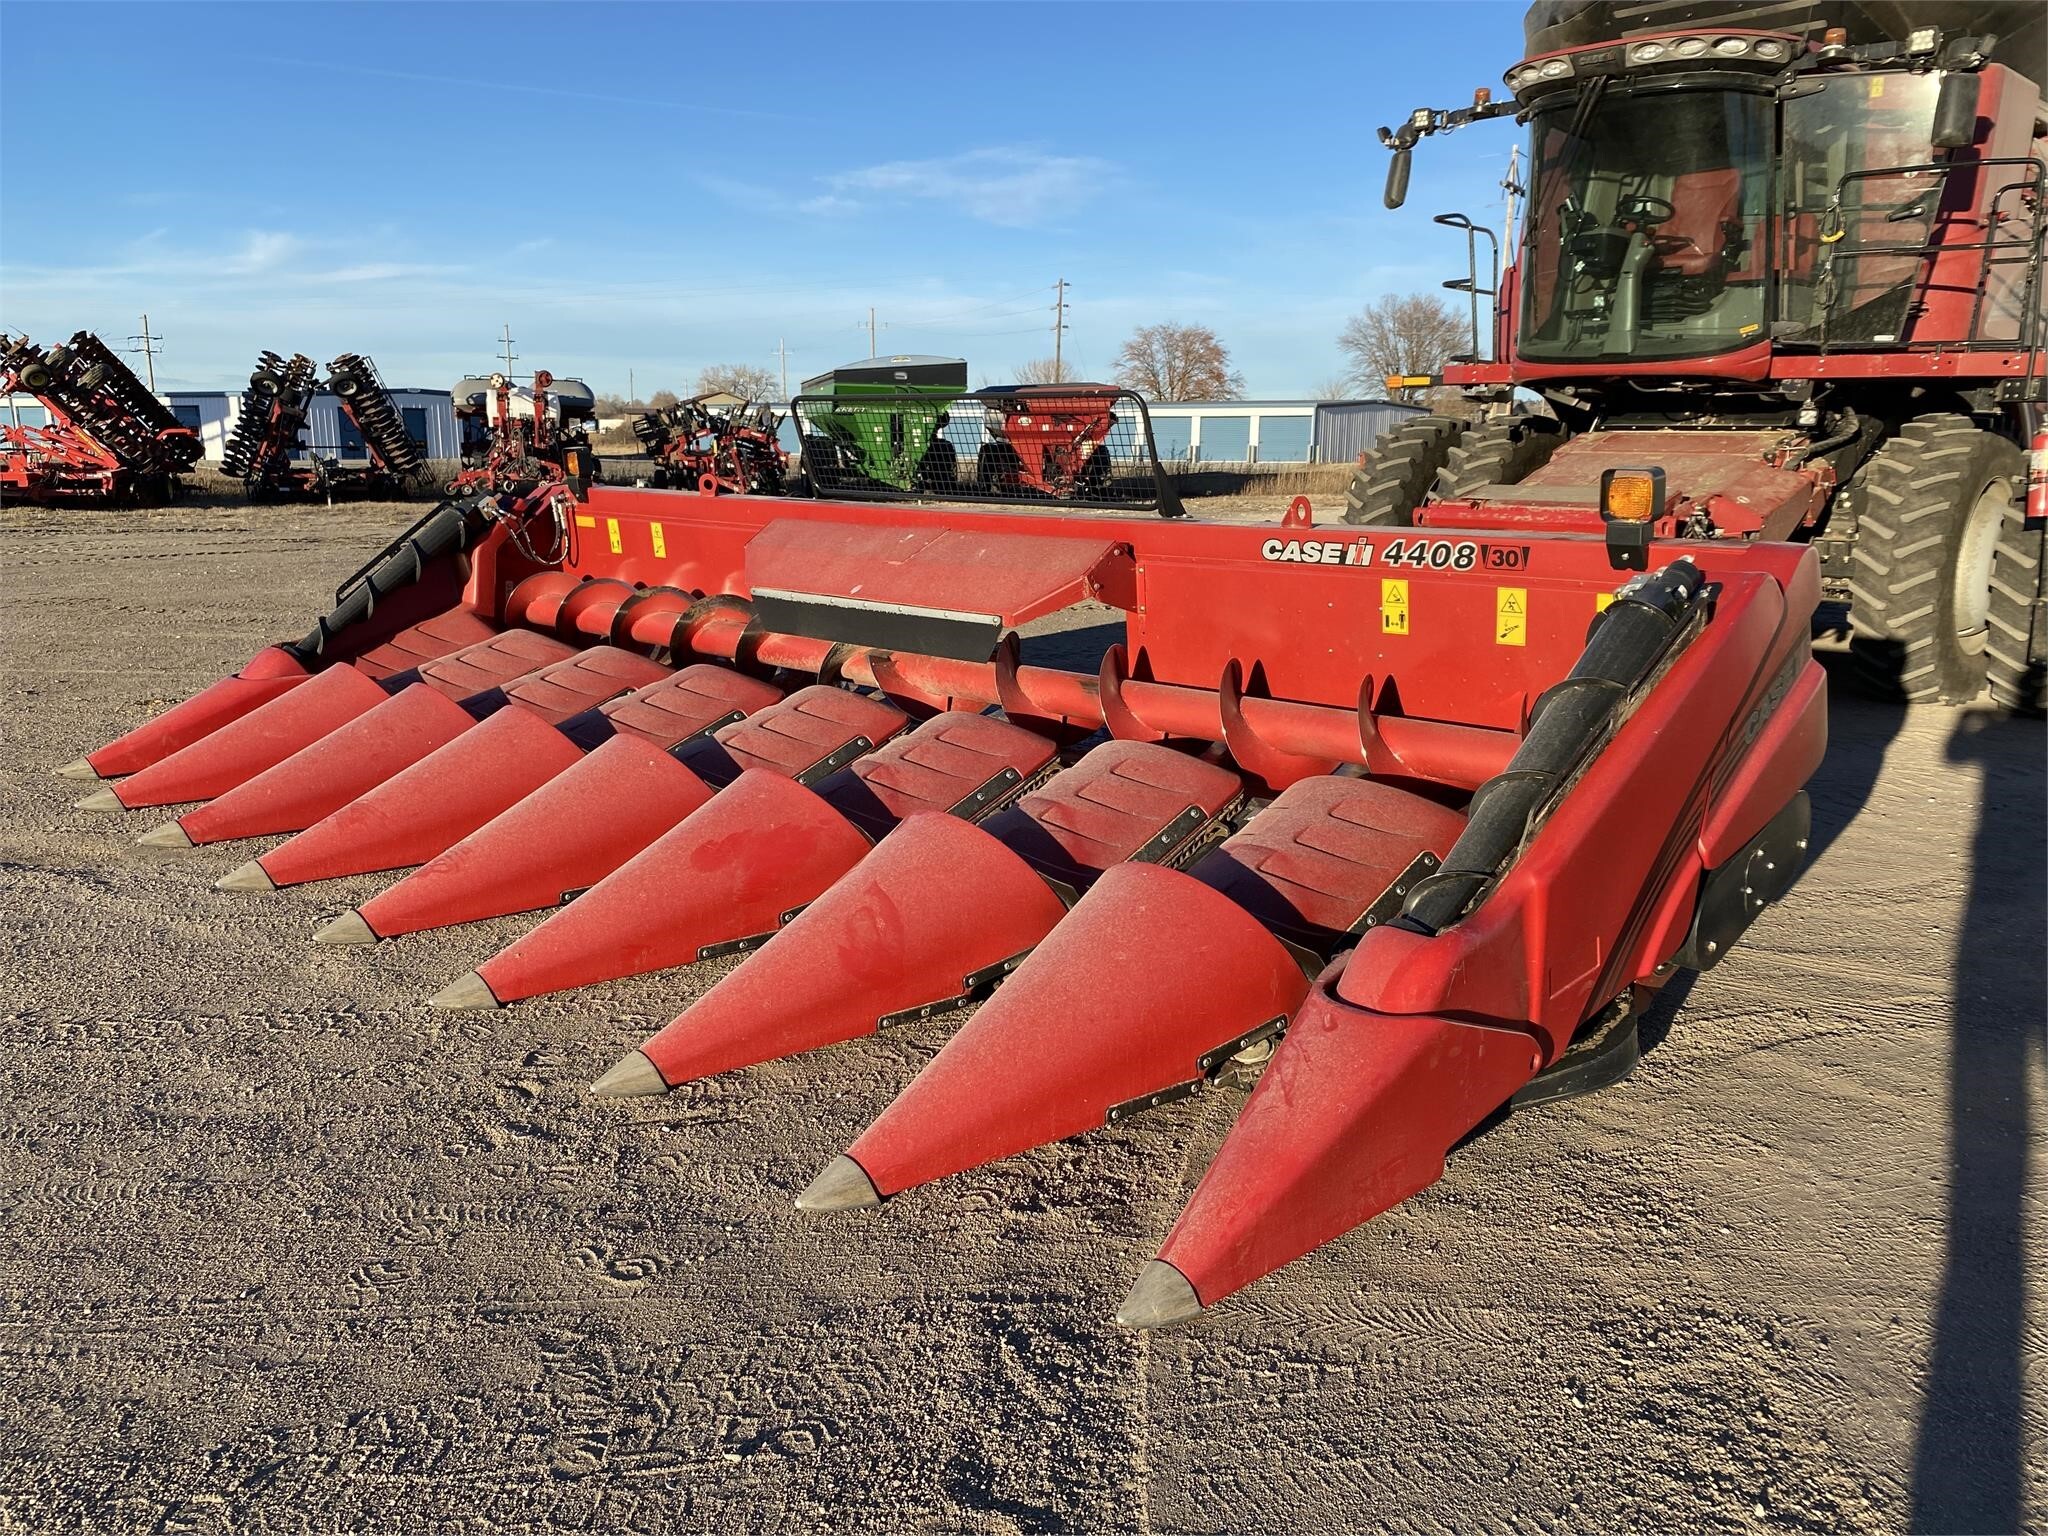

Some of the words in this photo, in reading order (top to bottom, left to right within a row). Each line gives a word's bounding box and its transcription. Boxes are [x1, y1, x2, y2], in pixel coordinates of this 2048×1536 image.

[1261, 538, 1343, 564] CASE
[1381, 538, 1478, 571] 4408
[1491, 549, 1519, 568] 30
